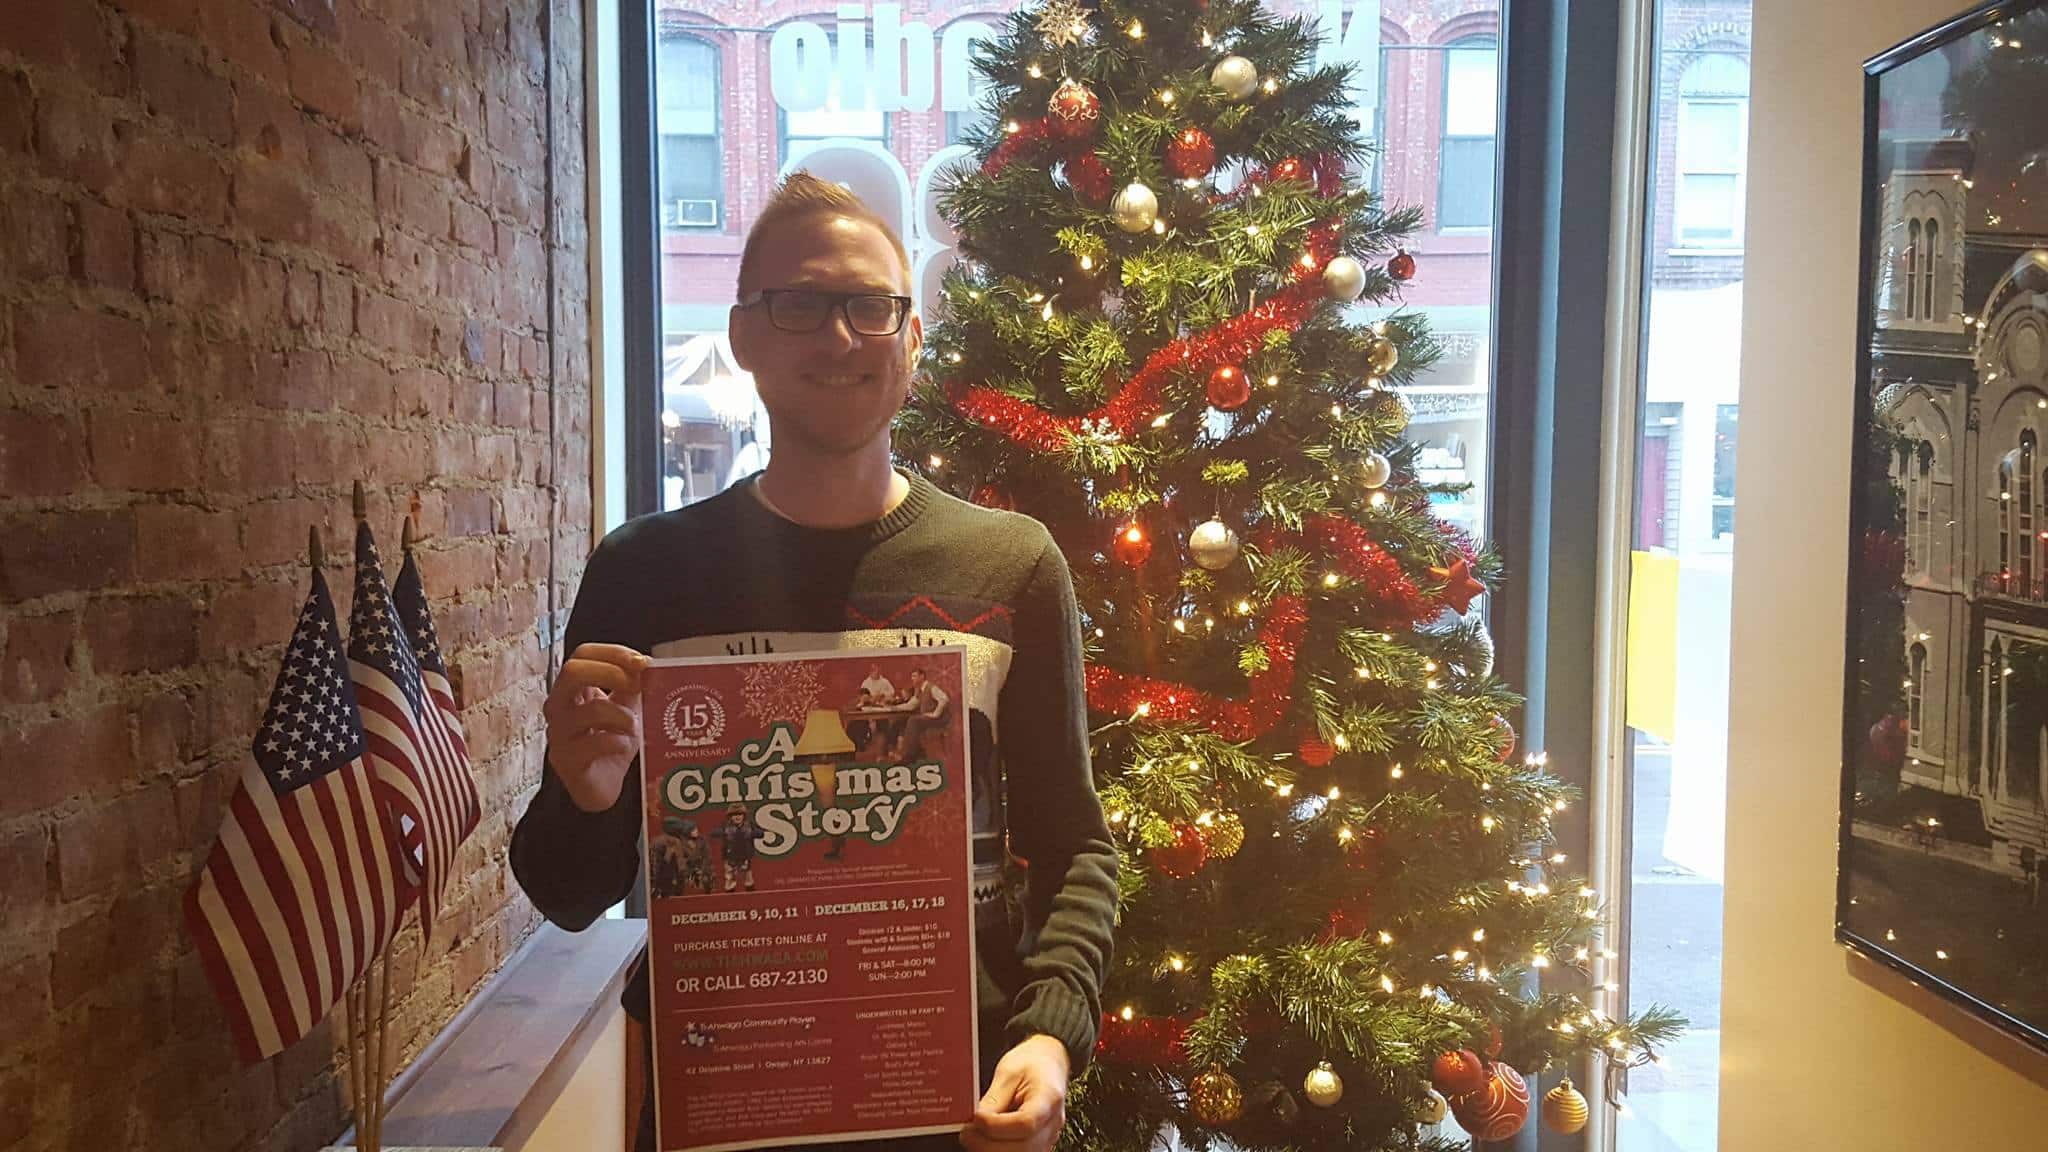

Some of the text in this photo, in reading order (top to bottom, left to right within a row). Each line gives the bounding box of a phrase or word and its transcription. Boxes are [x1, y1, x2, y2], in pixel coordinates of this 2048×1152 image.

[680, 704, 709, 730] 15
[741, 727, 796, 766] A
[753, 794, 917, 856] Story
[672, 907, 798, 925] DECEMBER 9, 10, 11
[815, 896, 945, 916] DECEMBER 16, 17, 18
[674, 932, 828, 953] PURCHASE TICKETS ONLINE AT
[858, 961, 872, 971] FRI
[923, 957, 936, 966] PM
[913, 969, 926, 977] PM
[676, 968, 828, 993] OR CALL 687-2130
[743, 1016, 788, 1028] Community
